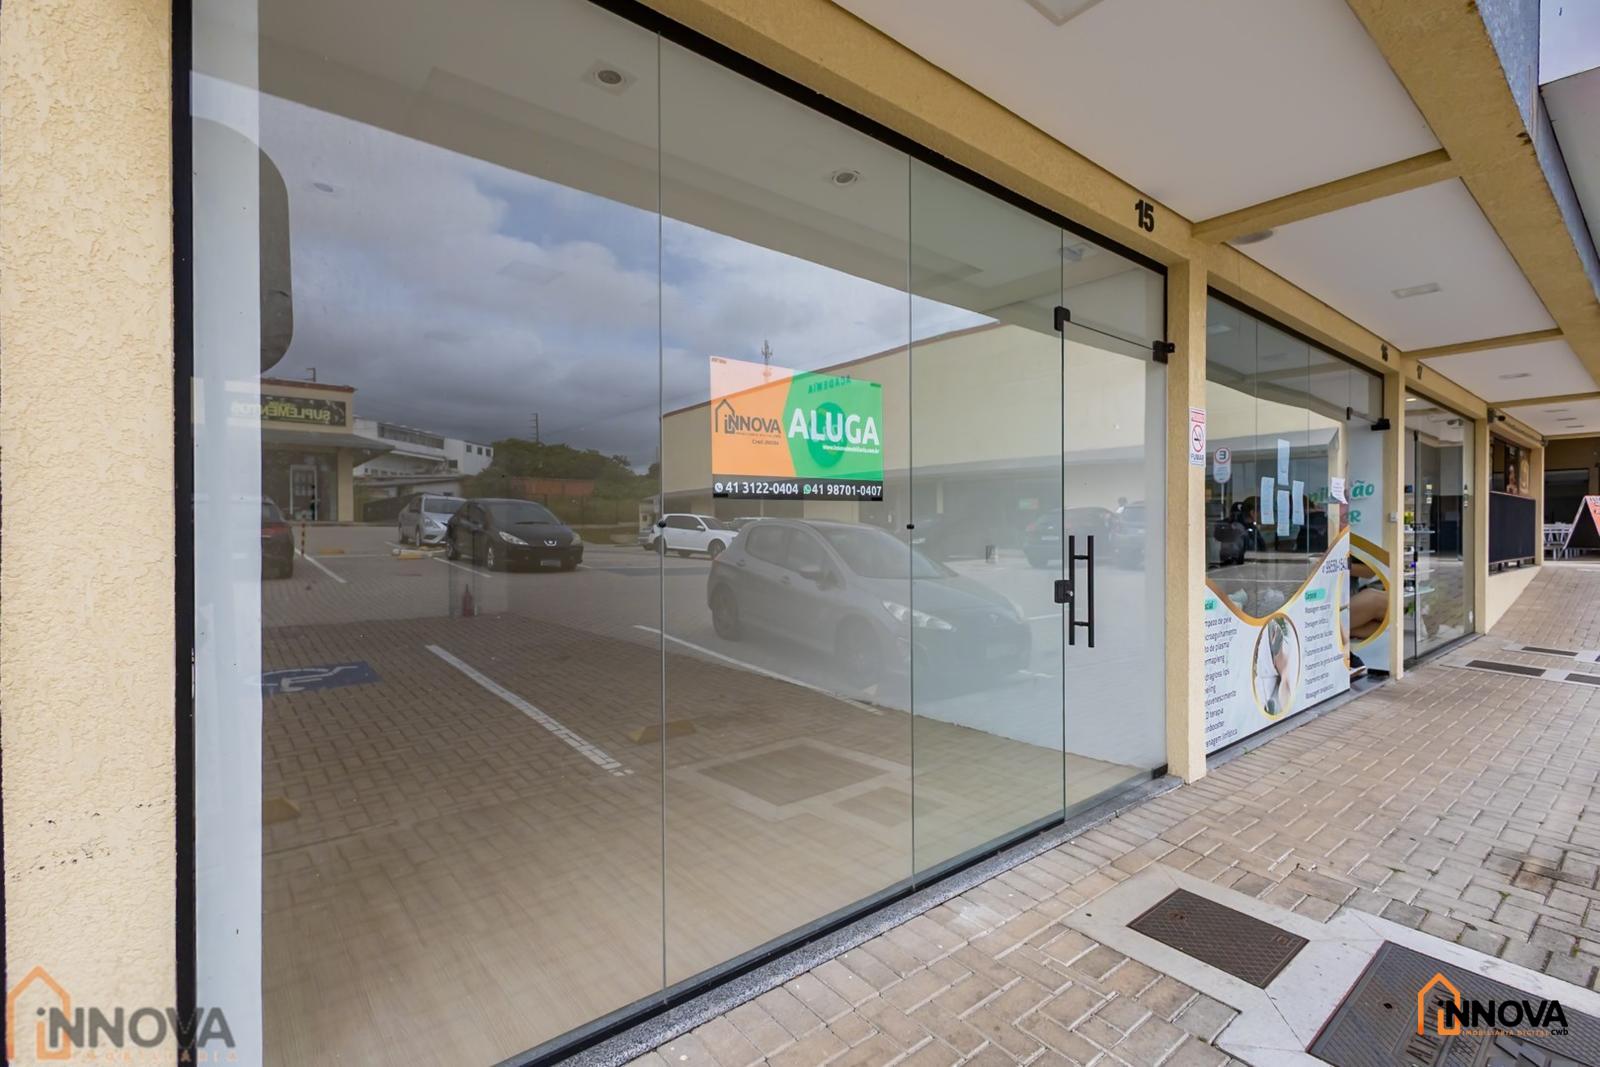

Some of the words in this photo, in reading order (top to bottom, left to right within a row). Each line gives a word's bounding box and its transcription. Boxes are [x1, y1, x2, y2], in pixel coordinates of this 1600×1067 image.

[1135, 199, 1155, 232] 15
[788, 408, 880, 446] ALUGA
[725, 482, 739, 493] 41
[743, 482, 799, 494] 3122-0404
[811, 484, 824, 495] 41
[827, 485, 882, 496] 98701-0407
